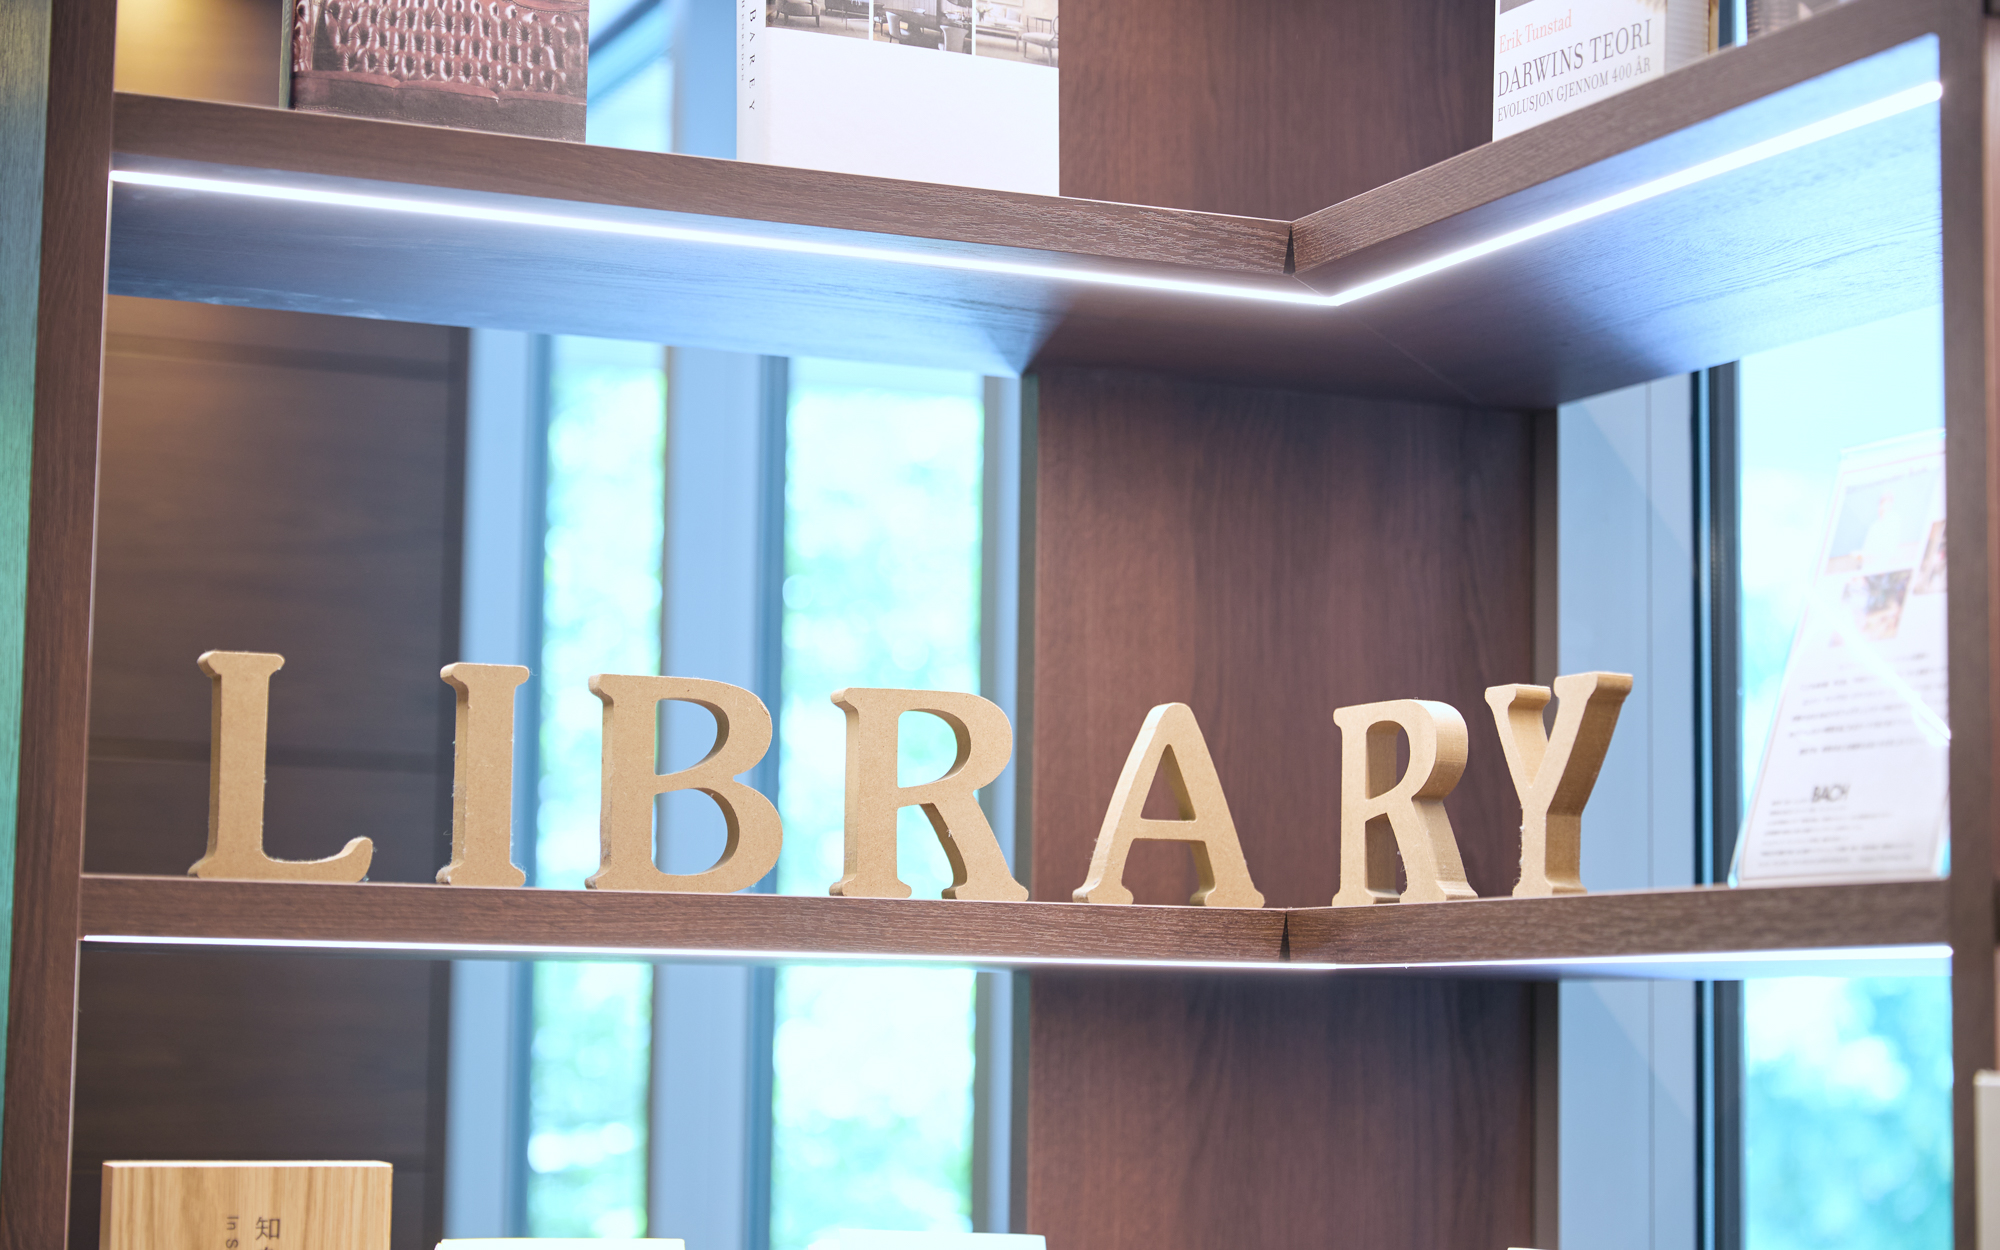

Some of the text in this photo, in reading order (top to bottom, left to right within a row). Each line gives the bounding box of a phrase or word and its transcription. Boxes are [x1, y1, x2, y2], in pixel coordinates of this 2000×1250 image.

[1498, 19, 1651, 97] DARWINS TEORI
[1499, 9, 1572, 54] Erik Tunstad
[1498, 55, 1651, 122] EVOLUSJON GJENNOM 400 ÅR
[187, 650, 1633, 909] LIBRARY
[255, 1216, 281, 1250] 知
